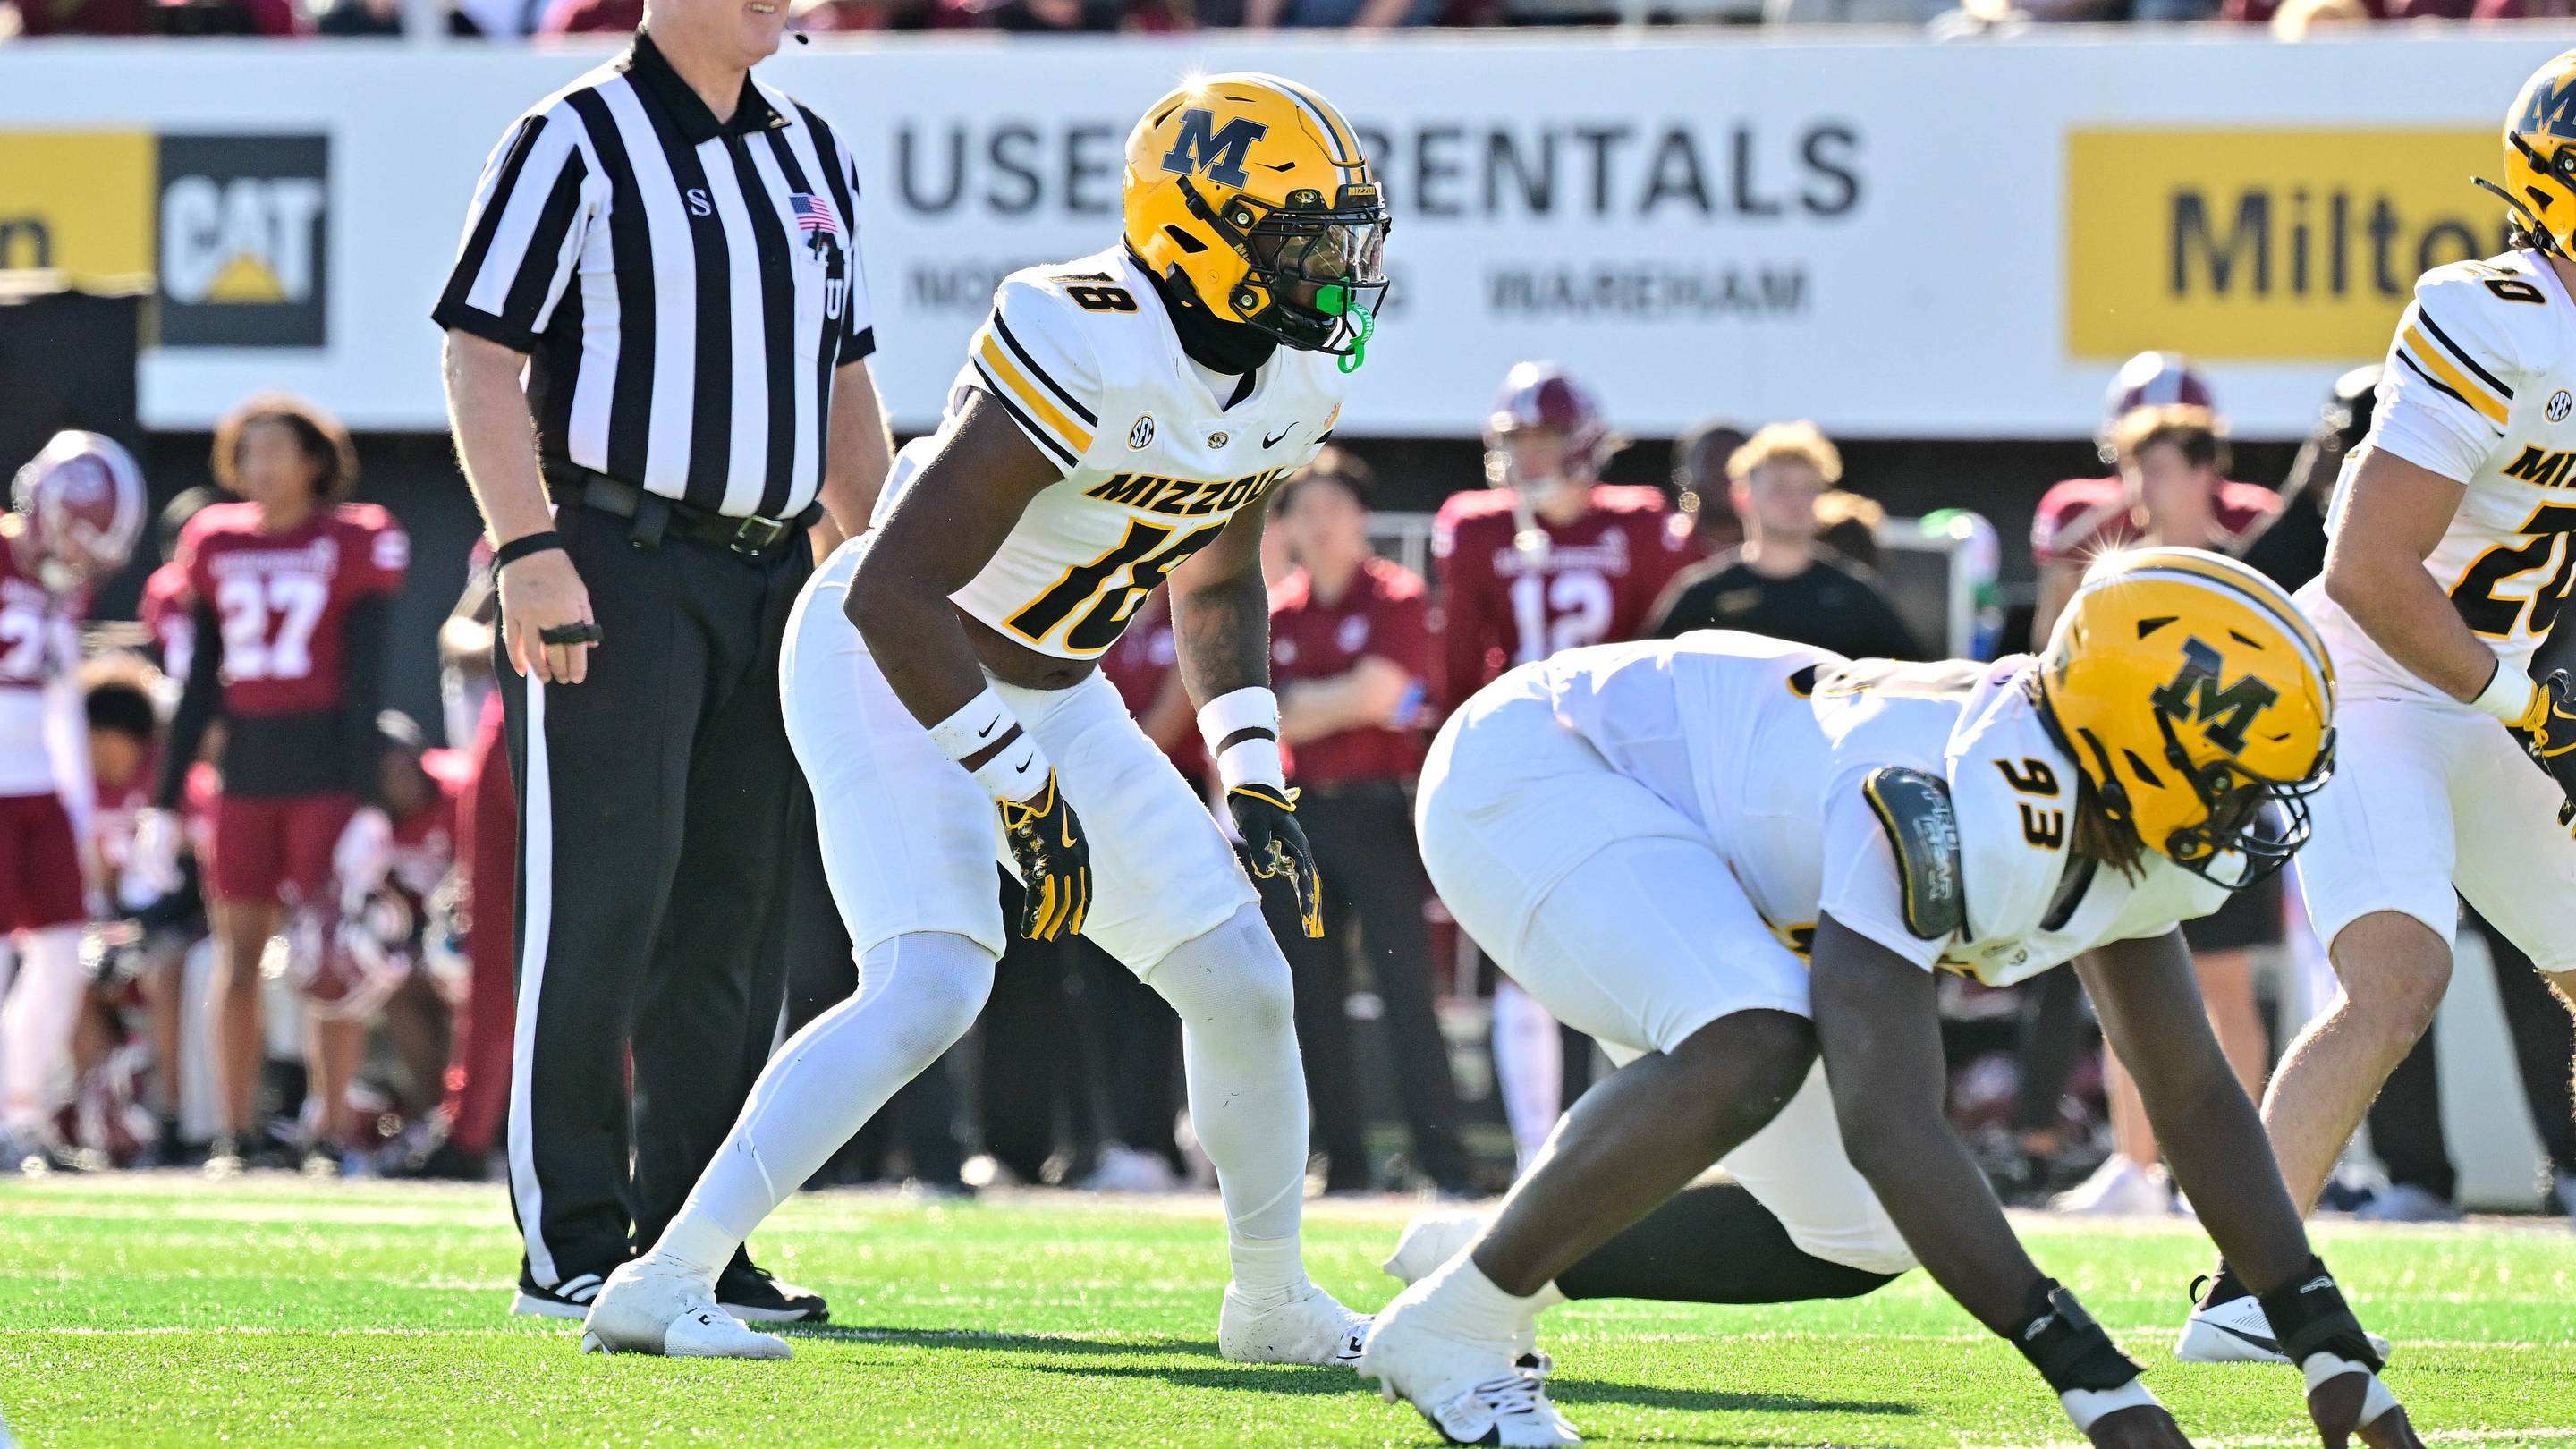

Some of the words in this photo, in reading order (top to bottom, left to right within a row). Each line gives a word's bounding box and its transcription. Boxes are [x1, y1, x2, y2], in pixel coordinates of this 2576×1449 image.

[1161, 107, 1269, 190] M
[162, 175, 322, 305] CAT
[687, 188, 712, 216] S
[2169, 186, 2510, 298] Milto
[826, 278, 843, 320] U
[1130, 416, 1155, 448] SEC
[2546, 391, 2572, 421] SEC
[1081, 465, 1288, 518] MIZZOU
[2500, 444, 2576, 489] MI
[215, 574, 328, 680] 27
[1002, 516, 1231, 654] 18
[1510, 570, 1614, 664] 12
[2149, 634, 2280, 758] M
[1990, 756, 2064, 853] 93
